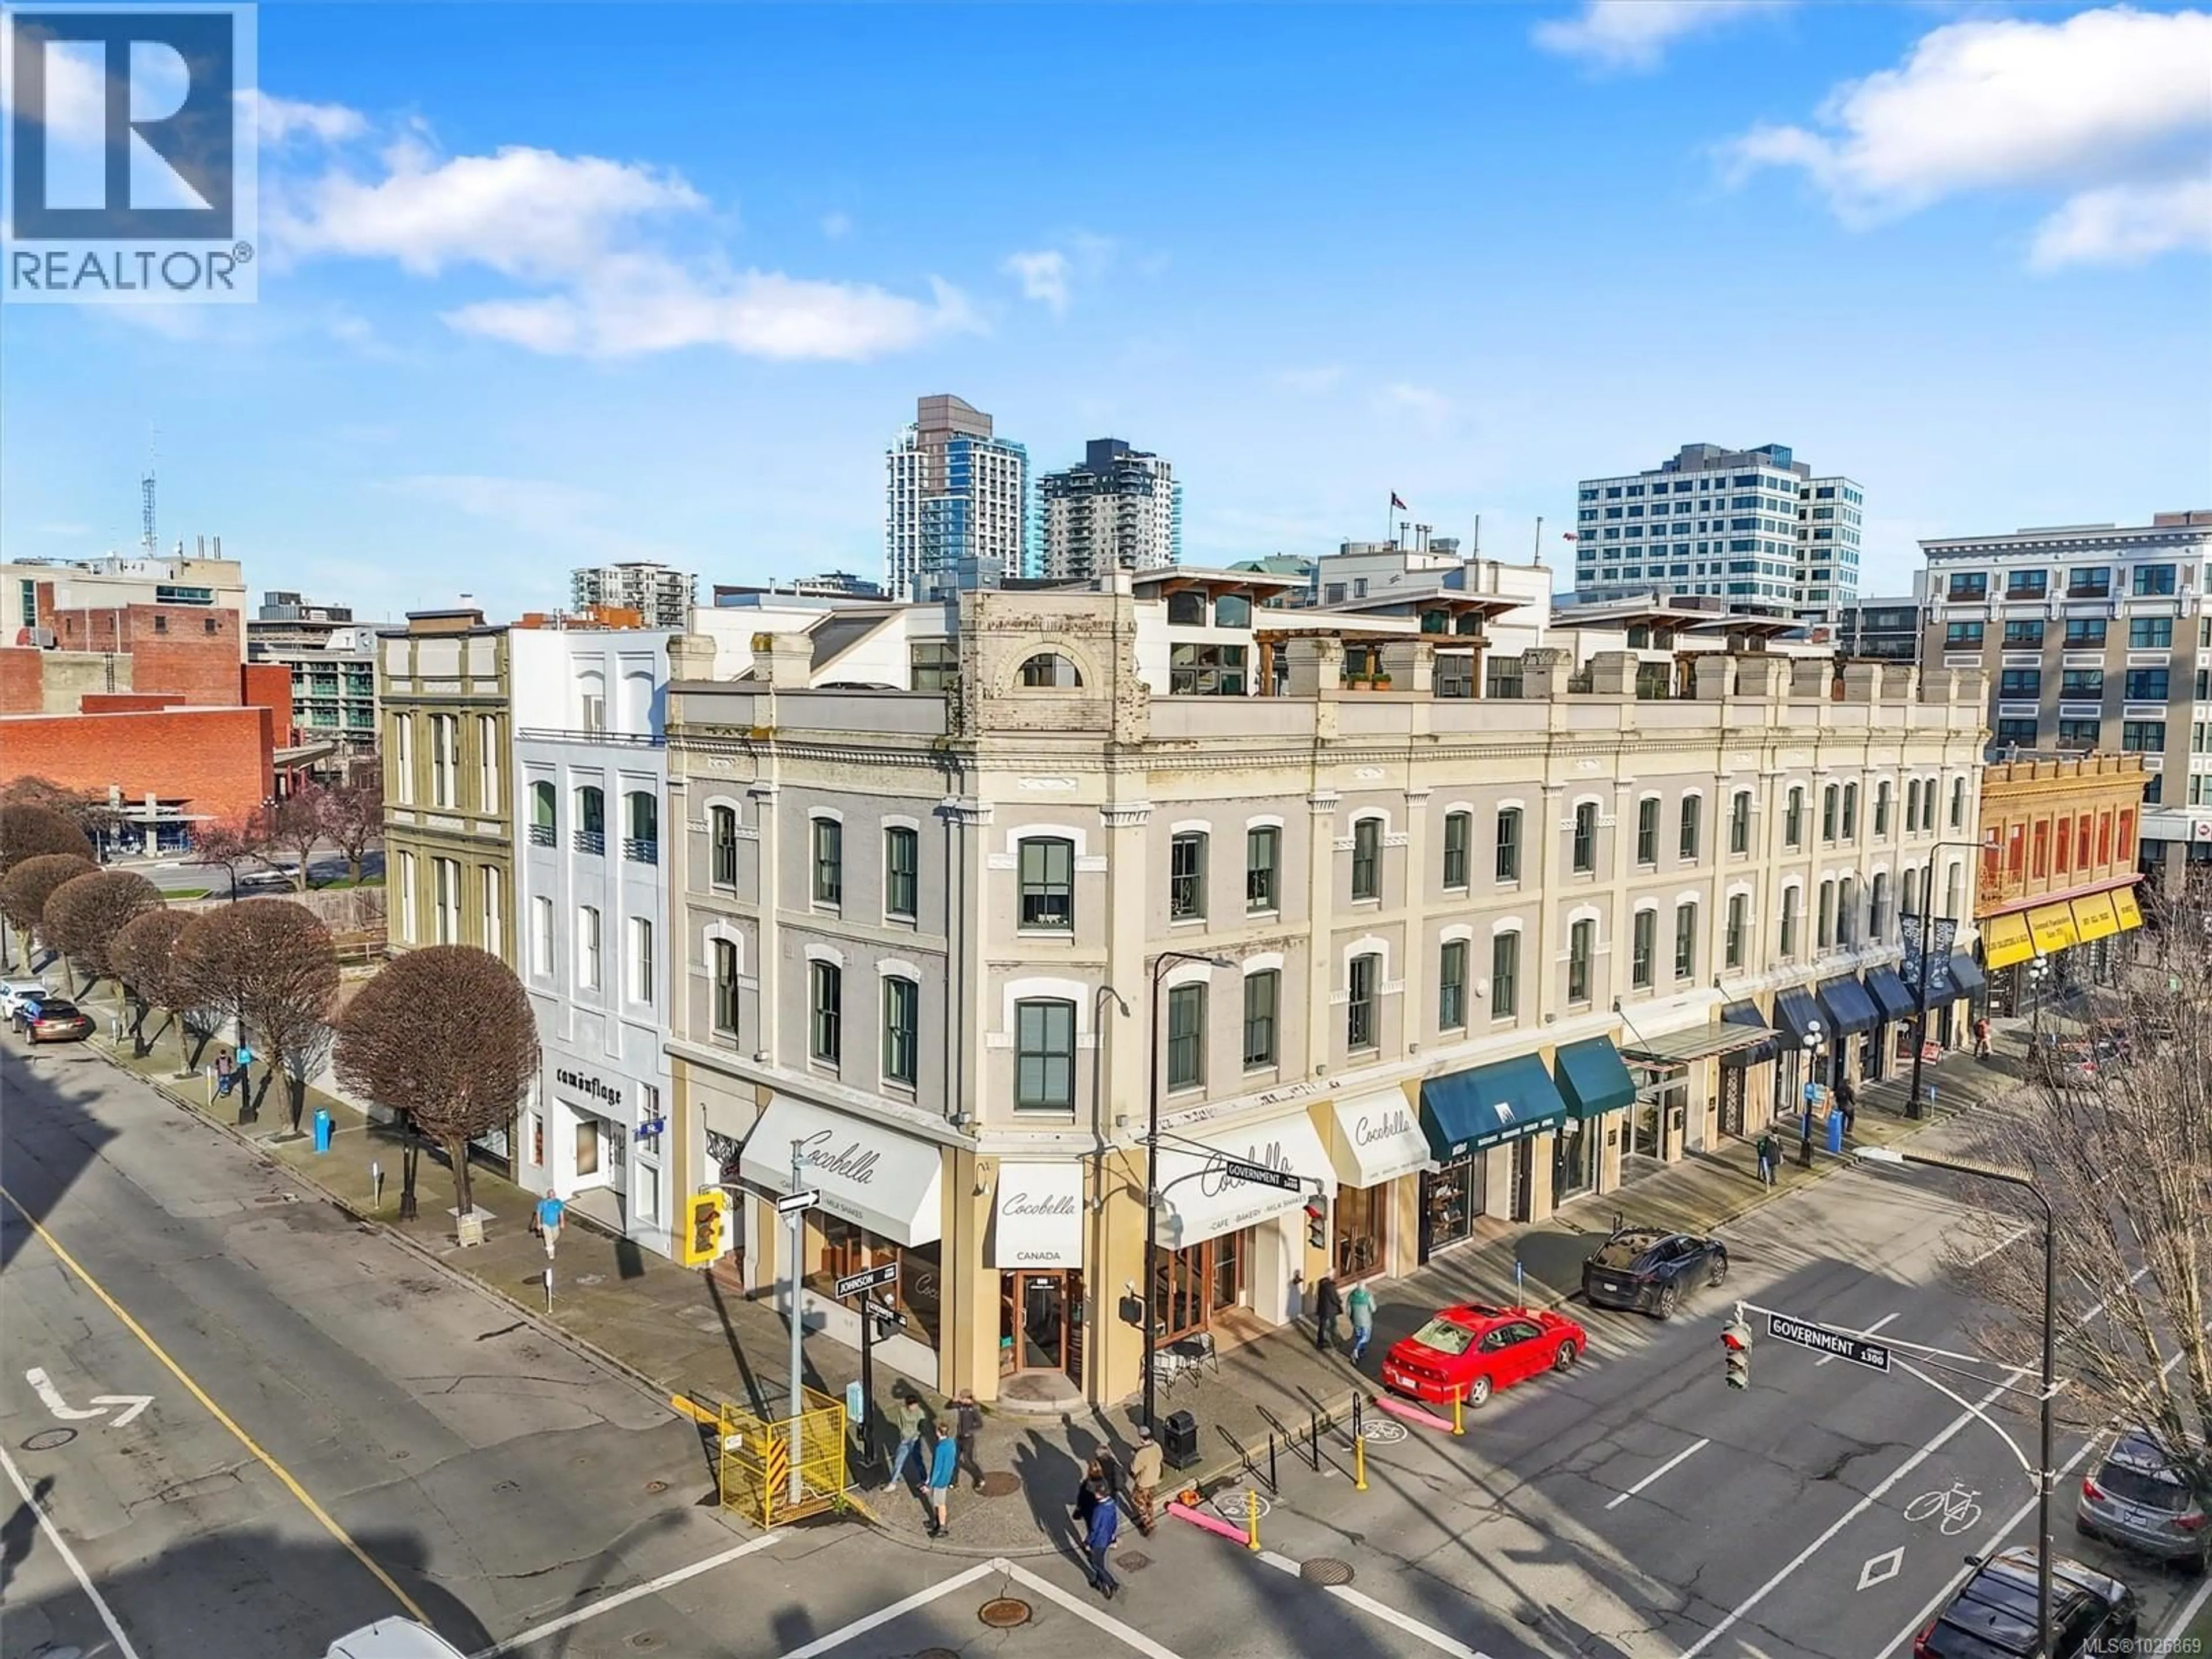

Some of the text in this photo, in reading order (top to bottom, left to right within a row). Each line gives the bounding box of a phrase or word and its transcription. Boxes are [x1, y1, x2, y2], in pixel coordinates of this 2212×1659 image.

[1356, 1110, 1412, 1146] Cocobella
[798, 1129, 880, 1184] Cocobella
[1228, 1164, 1281, 1184] GOVERNMENT
[1002, 1193, 1075, 1216] Cocobella
[1017, 1252, 1061, 1260] CANADA
[840, 1274, 874, 1294] JOHNSON
[1772, 1320, 1855, 1356] GOVERNMENT
[1860, 1351, 1884, 1366] 1300
